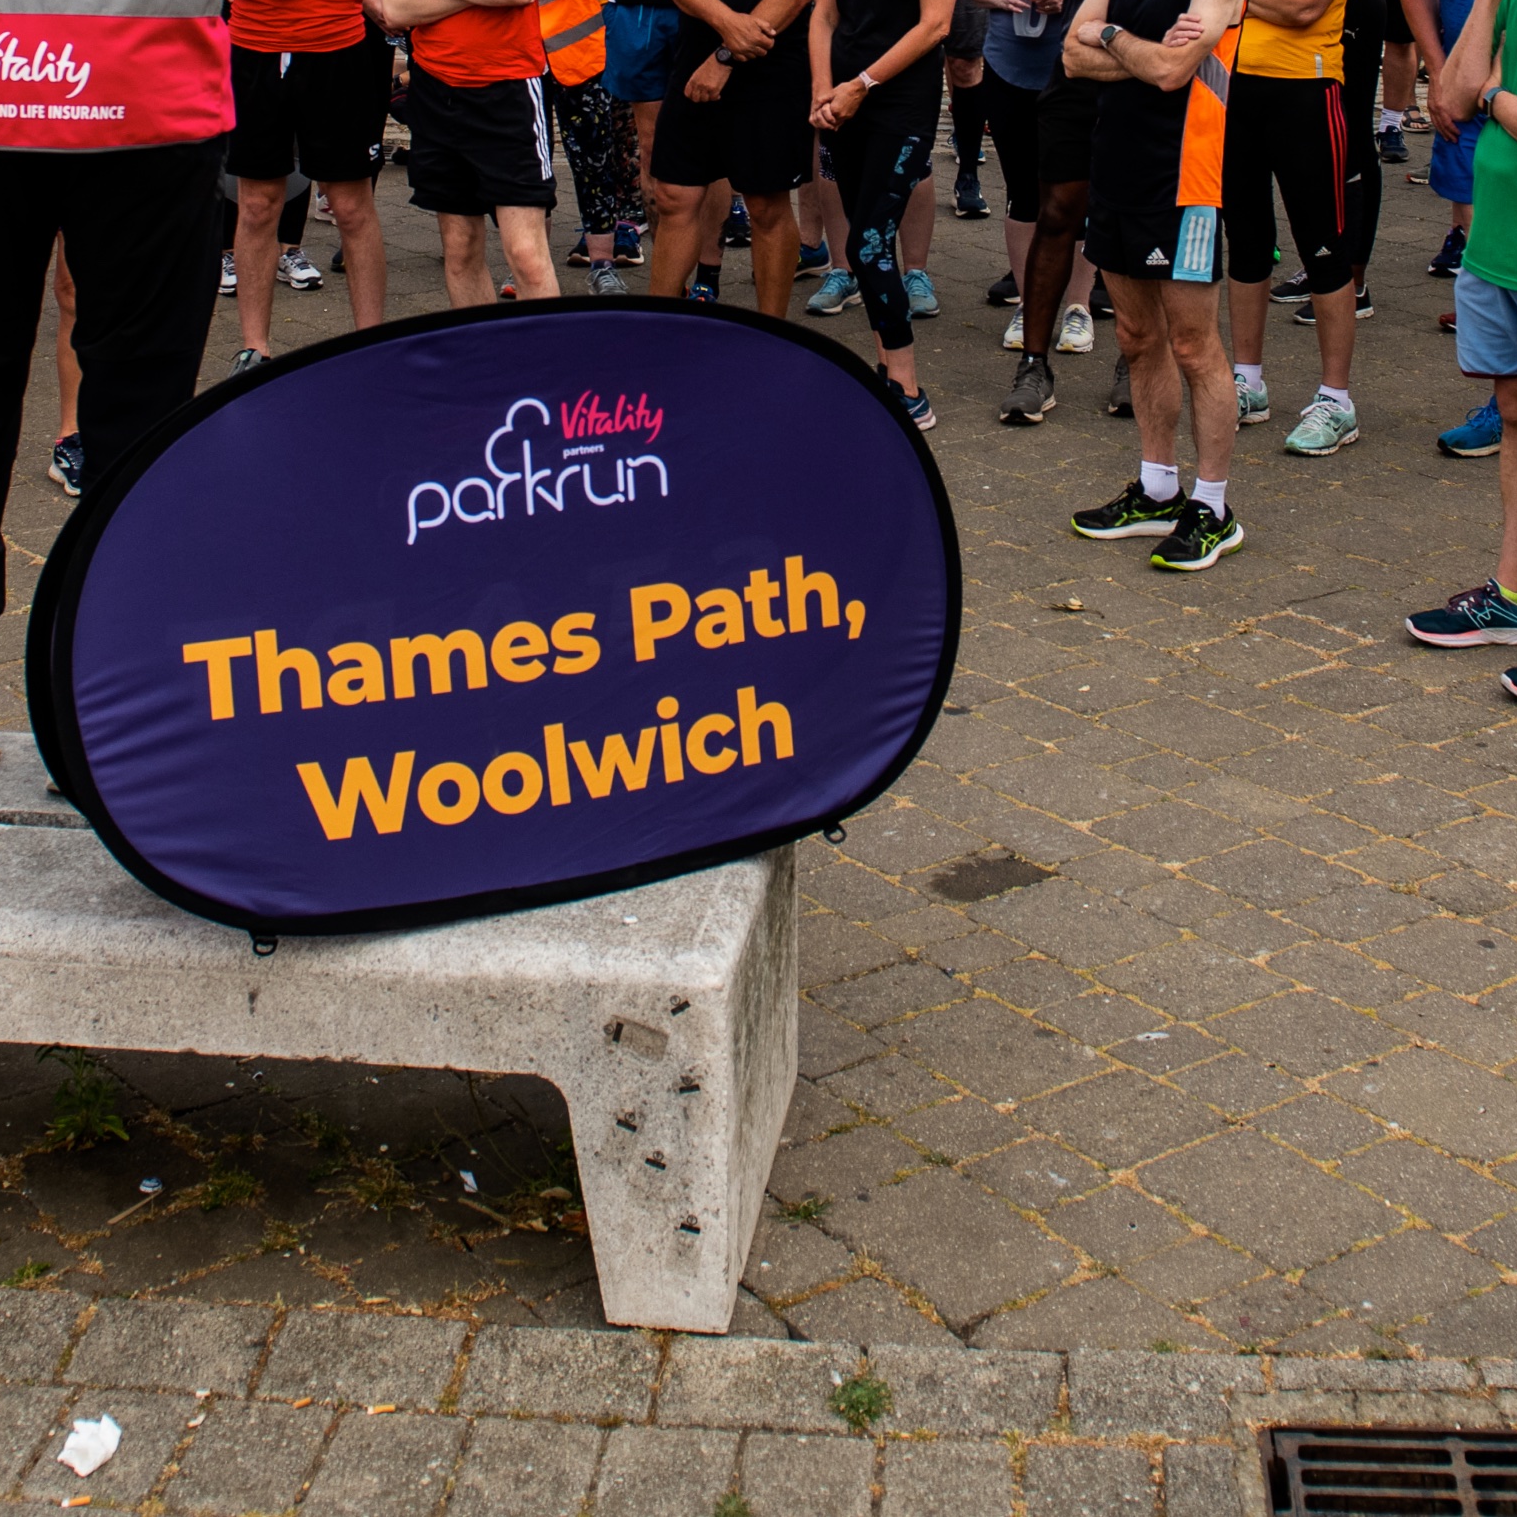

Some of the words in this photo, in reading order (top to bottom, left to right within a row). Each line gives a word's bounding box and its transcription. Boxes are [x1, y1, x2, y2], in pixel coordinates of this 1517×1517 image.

[20, 104, 44, 119] LIFE
[48, 105, 125, 120] INSURANCE
[562, 390, 664, 444] Vitality
[563, 444, 604, 459] partners
[407, 404, 669, 546] parkrun
[184, 611, 601, 721] Thames
[629, 555, 867, 663] Path,
[297, 686, 794, 841] Woolwich
